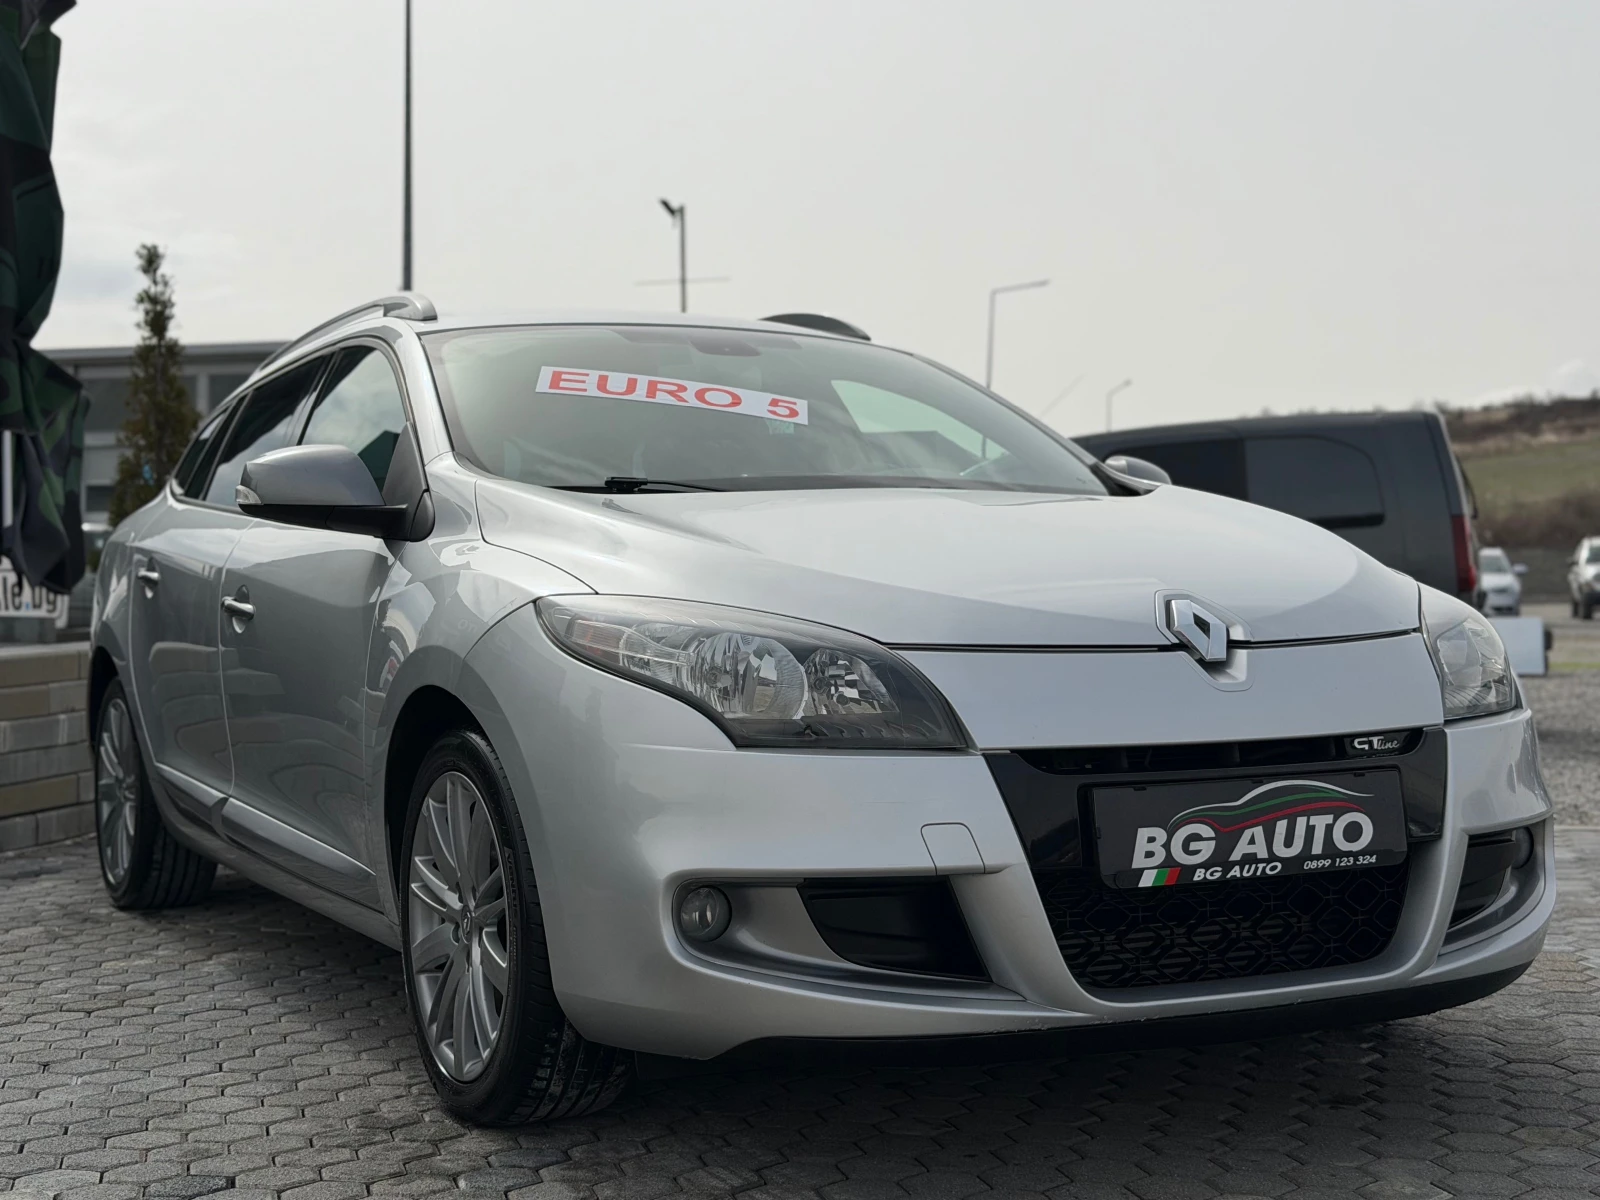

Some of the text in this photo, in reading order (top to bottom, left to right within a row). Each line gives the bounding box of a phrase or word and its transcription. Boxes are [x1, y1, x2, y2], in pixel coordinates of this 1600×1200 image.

[548, 370, 800, 419] EURO 5
[1131, 811, 1374, 869] BG AUTO
[1192, 861, 1282, 881] BG AUTO
[1303, 855, 1377, 870] 0899 123 324
